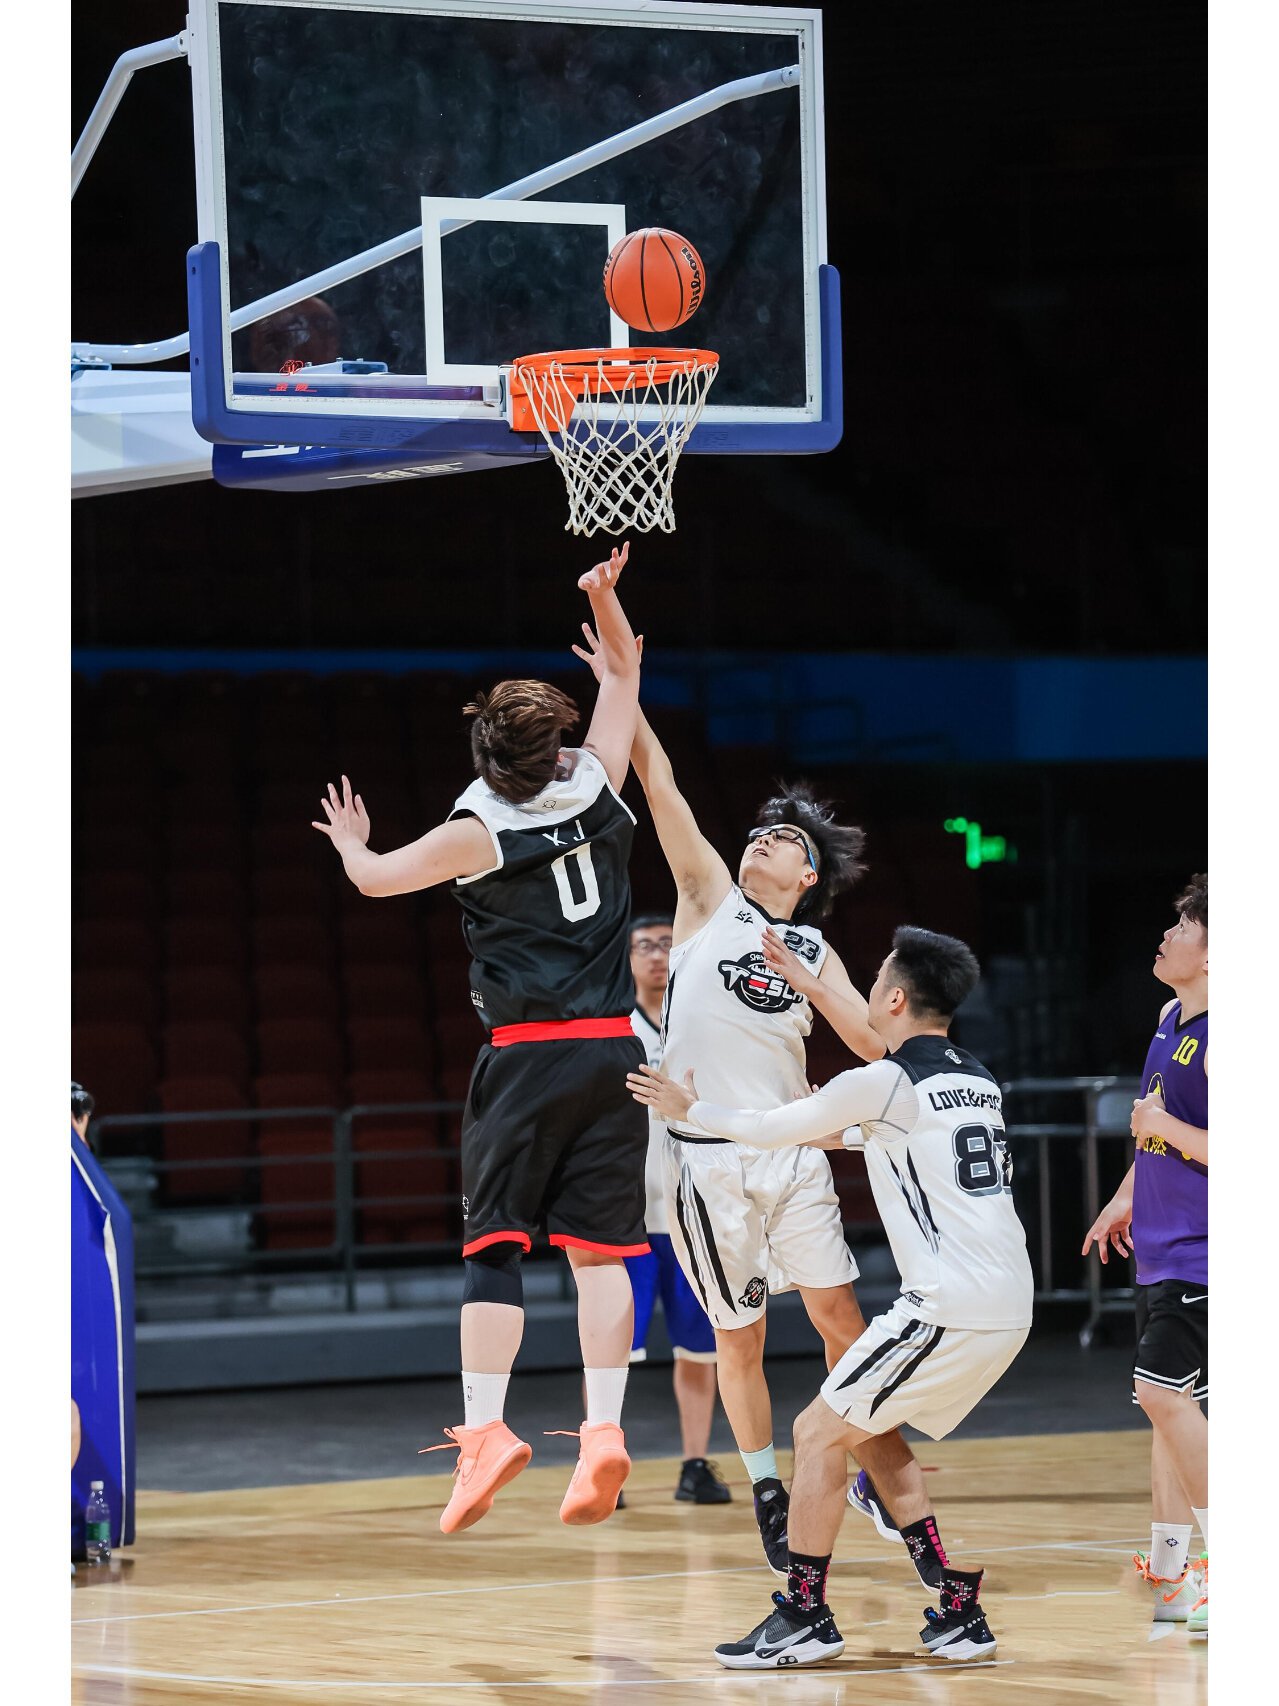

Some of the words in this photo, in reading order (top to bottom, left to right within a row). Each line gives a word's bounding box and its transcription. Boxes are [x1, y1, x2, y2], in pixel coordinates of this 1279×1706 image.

[551, 842, 601, 922] 0
[783, 930, 821, 964] 23
[1172, 1035, 1199, 1066] 10
